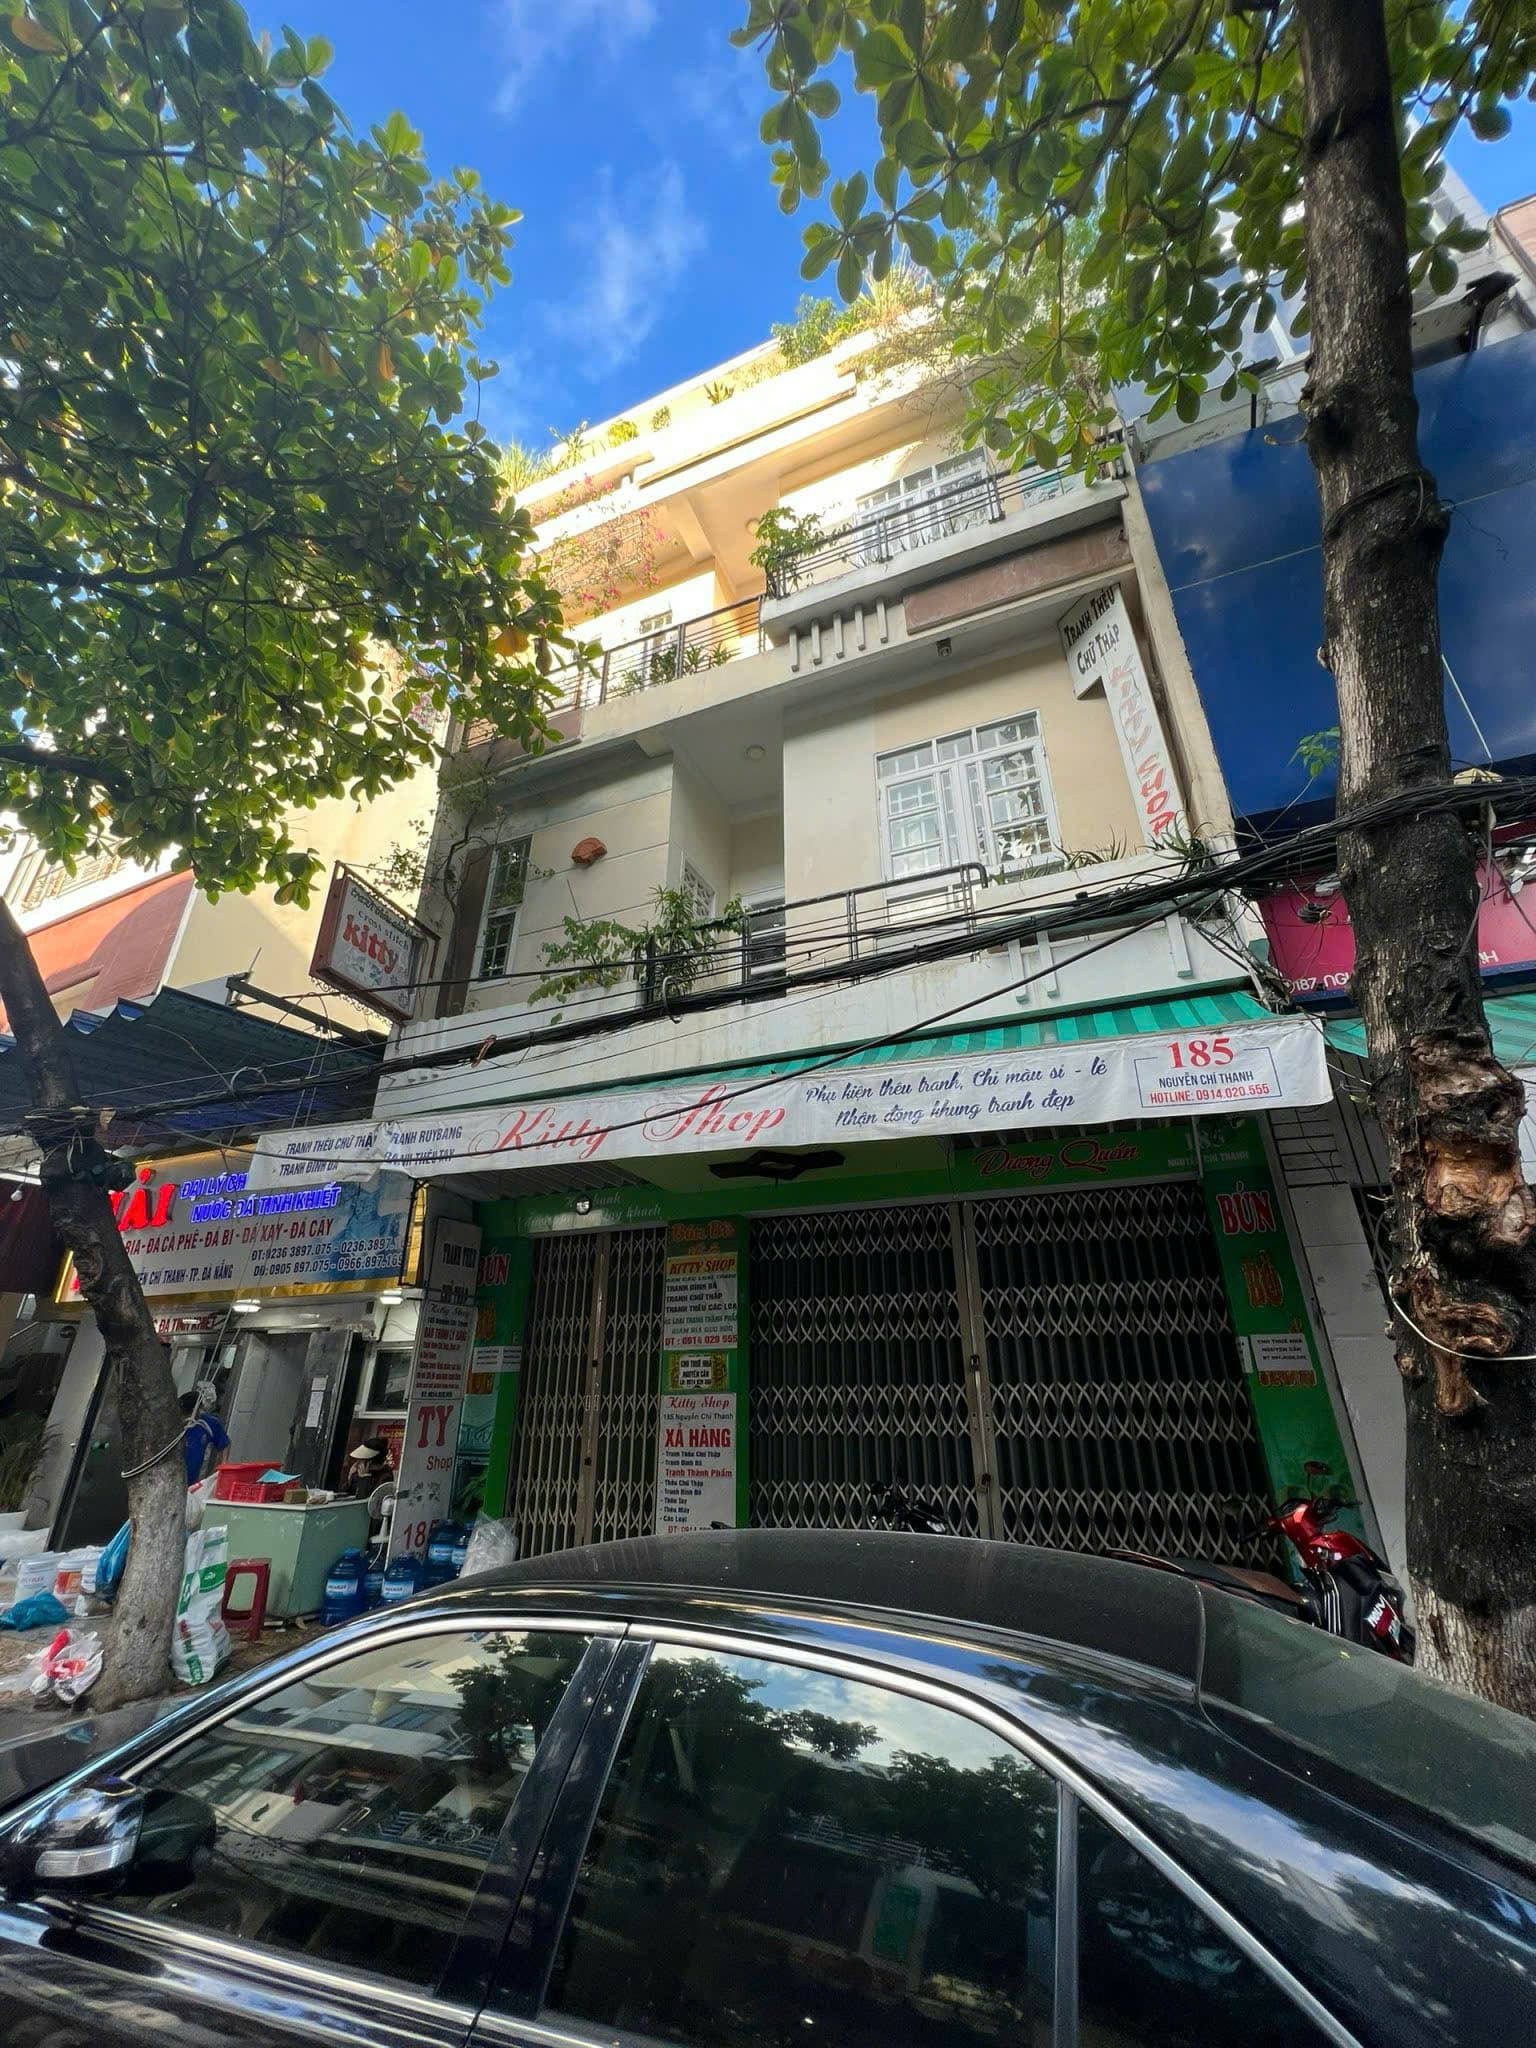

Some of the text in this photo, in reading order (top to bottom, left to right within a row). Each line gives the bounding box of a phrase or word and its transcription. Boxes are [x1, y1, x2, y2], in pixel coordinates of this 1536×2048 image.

[1063, 606, 1093, 647] TRANH
[1076, 638, 1097, 675] CHỮ
[1294, 977, 1316, 992] 187
[1167, 1037, 1234, 1069] 185
[806, 1086, 837, 1104] Phụ
[841, 1081, 873, 1101] kiện
[878, 1077, 913, 1097] thêu
[1005, 1067, 1042, 1083] màu
[1158, 1070, 1254, 1088] NGUYỄN CHÍ THANH
[1150, 1083, 1270, 1104] HOTLINE: 0914.020.555
[835, 1106, 877, 1128] Nhận
[930, 1099, 982, 1120] khung
[988, 1091, 1034, 1113] tranh
[1041, 1088, 1076, 1112] đẹp
[468, 1084, 786, 1161] Kitty Shop
[286, 1142, 312, 1156] TRANH
[313, 1137, 334, 1153] THÊU
[279, 1162, 305, 1177] TRANH
[180, 1178, 206, 1201] ĐẠI
[205, 1172, 227, 1196] LÝ
[190, 1197, 233, 1224] NƯỚC
[294, 1181, 342, 1212] KHIẾT
[1215, 1180, 1277, 1235] BÚN
[221, 1228, 234, 1247] BI
[289, 1242, 332, 1259] 3897.075
[162, 1269, 187, 1283] THANH
[293, 1259, 330, 1274] 897.075
[669, 1258, 736, 1275] KITTY SHOP
[700, 1394, 731, 1411] Shop
[417, 1405, 454, 1449] TY
[664, 1422, 732, 1448] XẢ HÀNG
[426, 1455, 454, 1472] Shop
